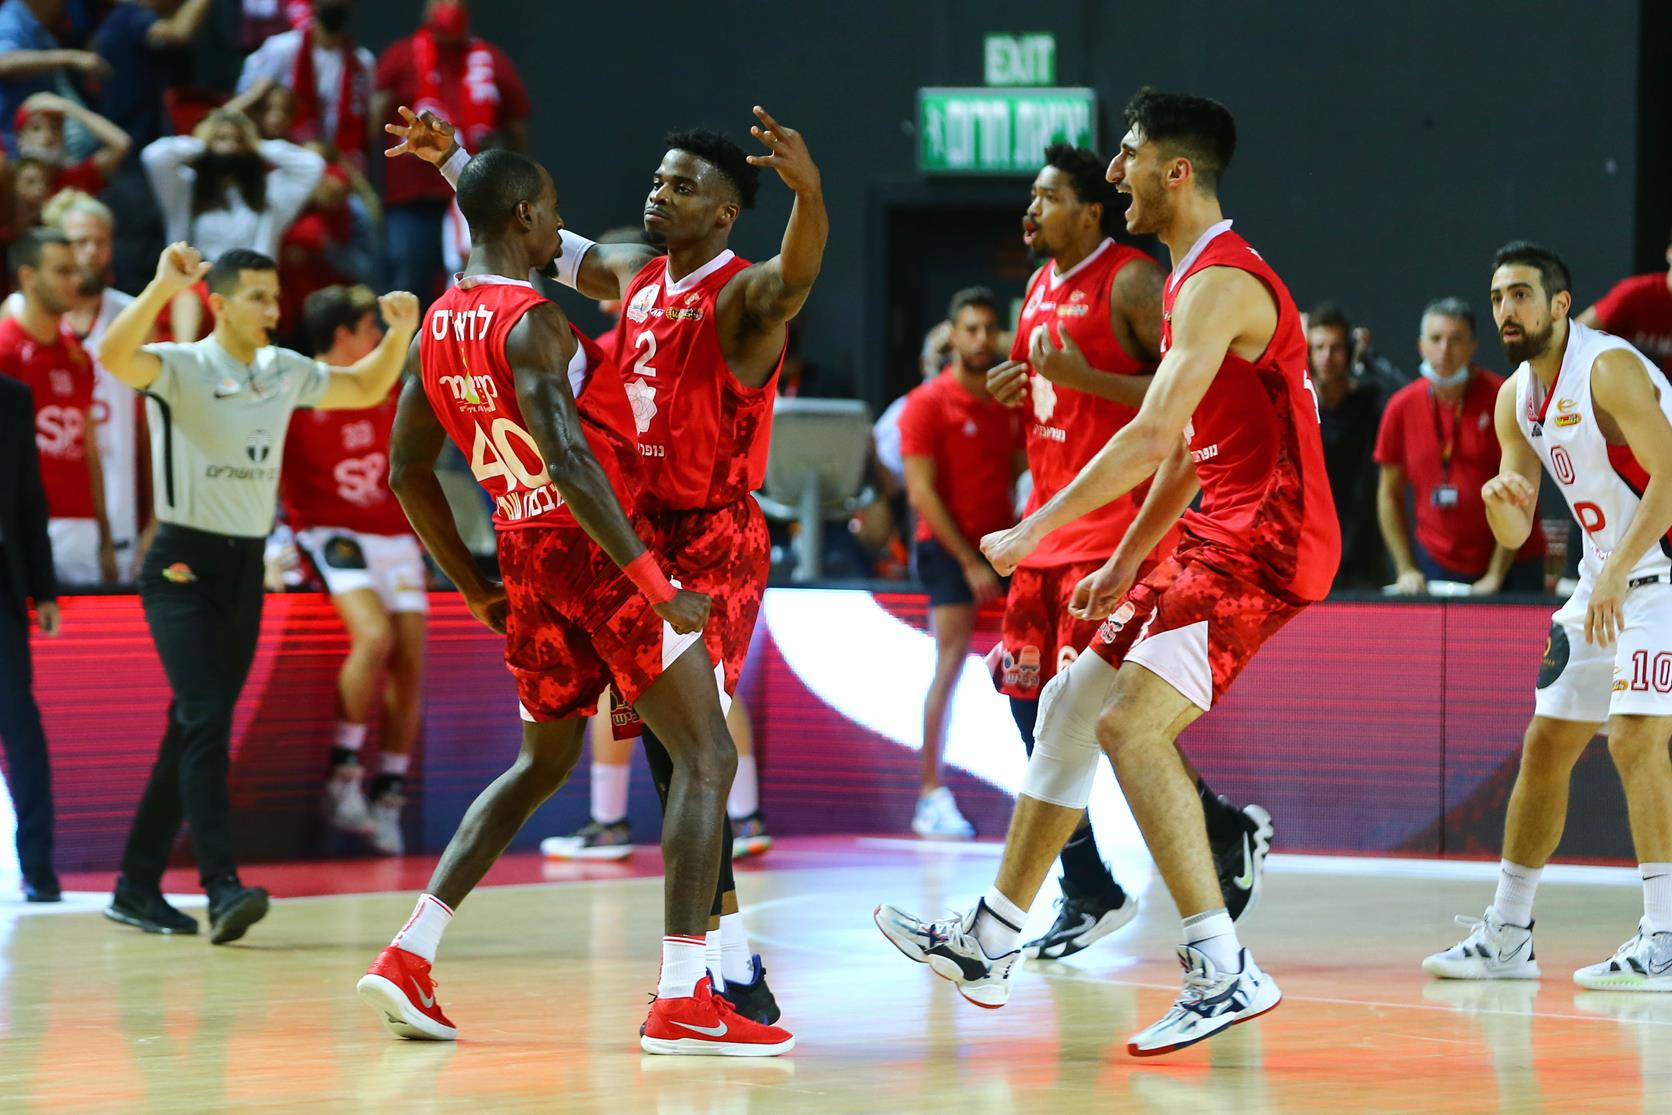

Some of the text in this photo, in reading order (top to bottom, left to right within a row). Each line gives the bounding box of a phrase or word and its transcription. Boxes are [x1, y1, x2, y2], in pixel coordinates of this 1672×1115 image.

[985, 34, 1054, 85] EXIT
[432, 304, 494, 342] לואיס
[633, 329, 657, 377] 2
[471, 417, 552, 492] 40
[1631, 649, 1672, 693] 10
